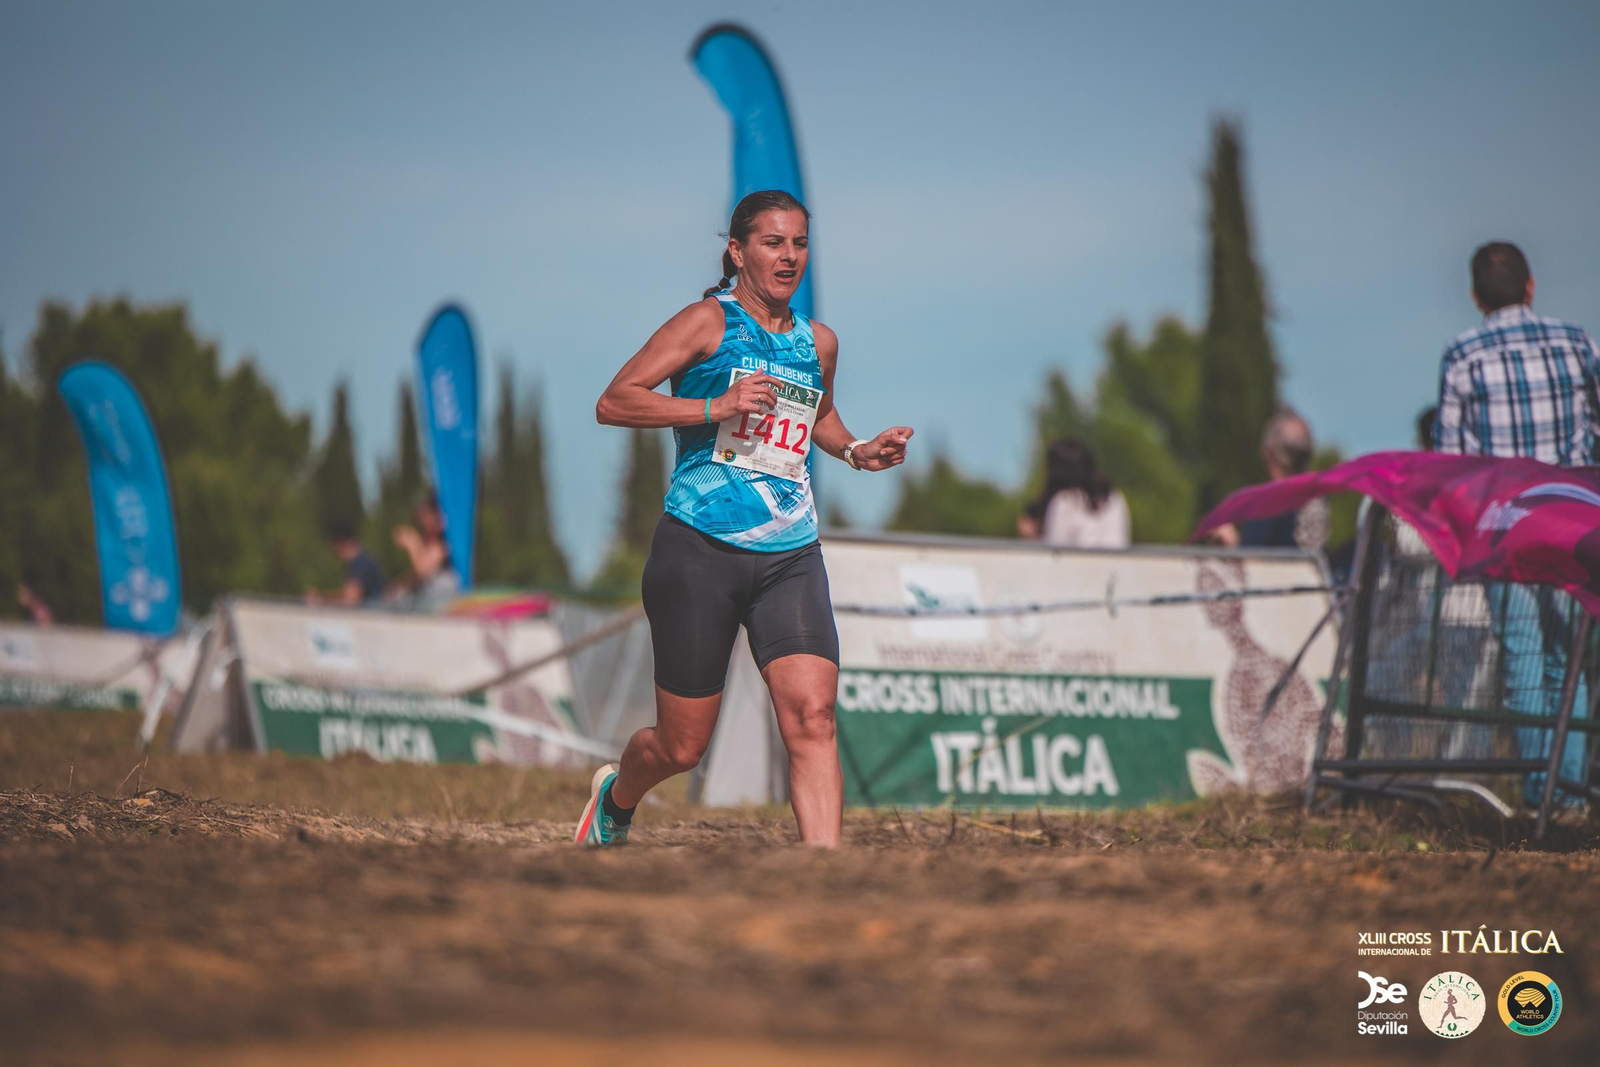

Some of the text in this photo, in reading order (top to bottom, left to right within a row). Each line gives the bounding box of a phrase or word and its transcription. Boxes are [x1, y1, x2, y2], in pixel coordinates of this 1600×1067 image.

[742, 356, 813, 386] CLUB ONUBENSE
[731, 411, 808, 456] 1412
[839, 672, 1182, 720] CROSS INTERNACIONAL
[931, 716, 1120, 797] ITÁLICA
